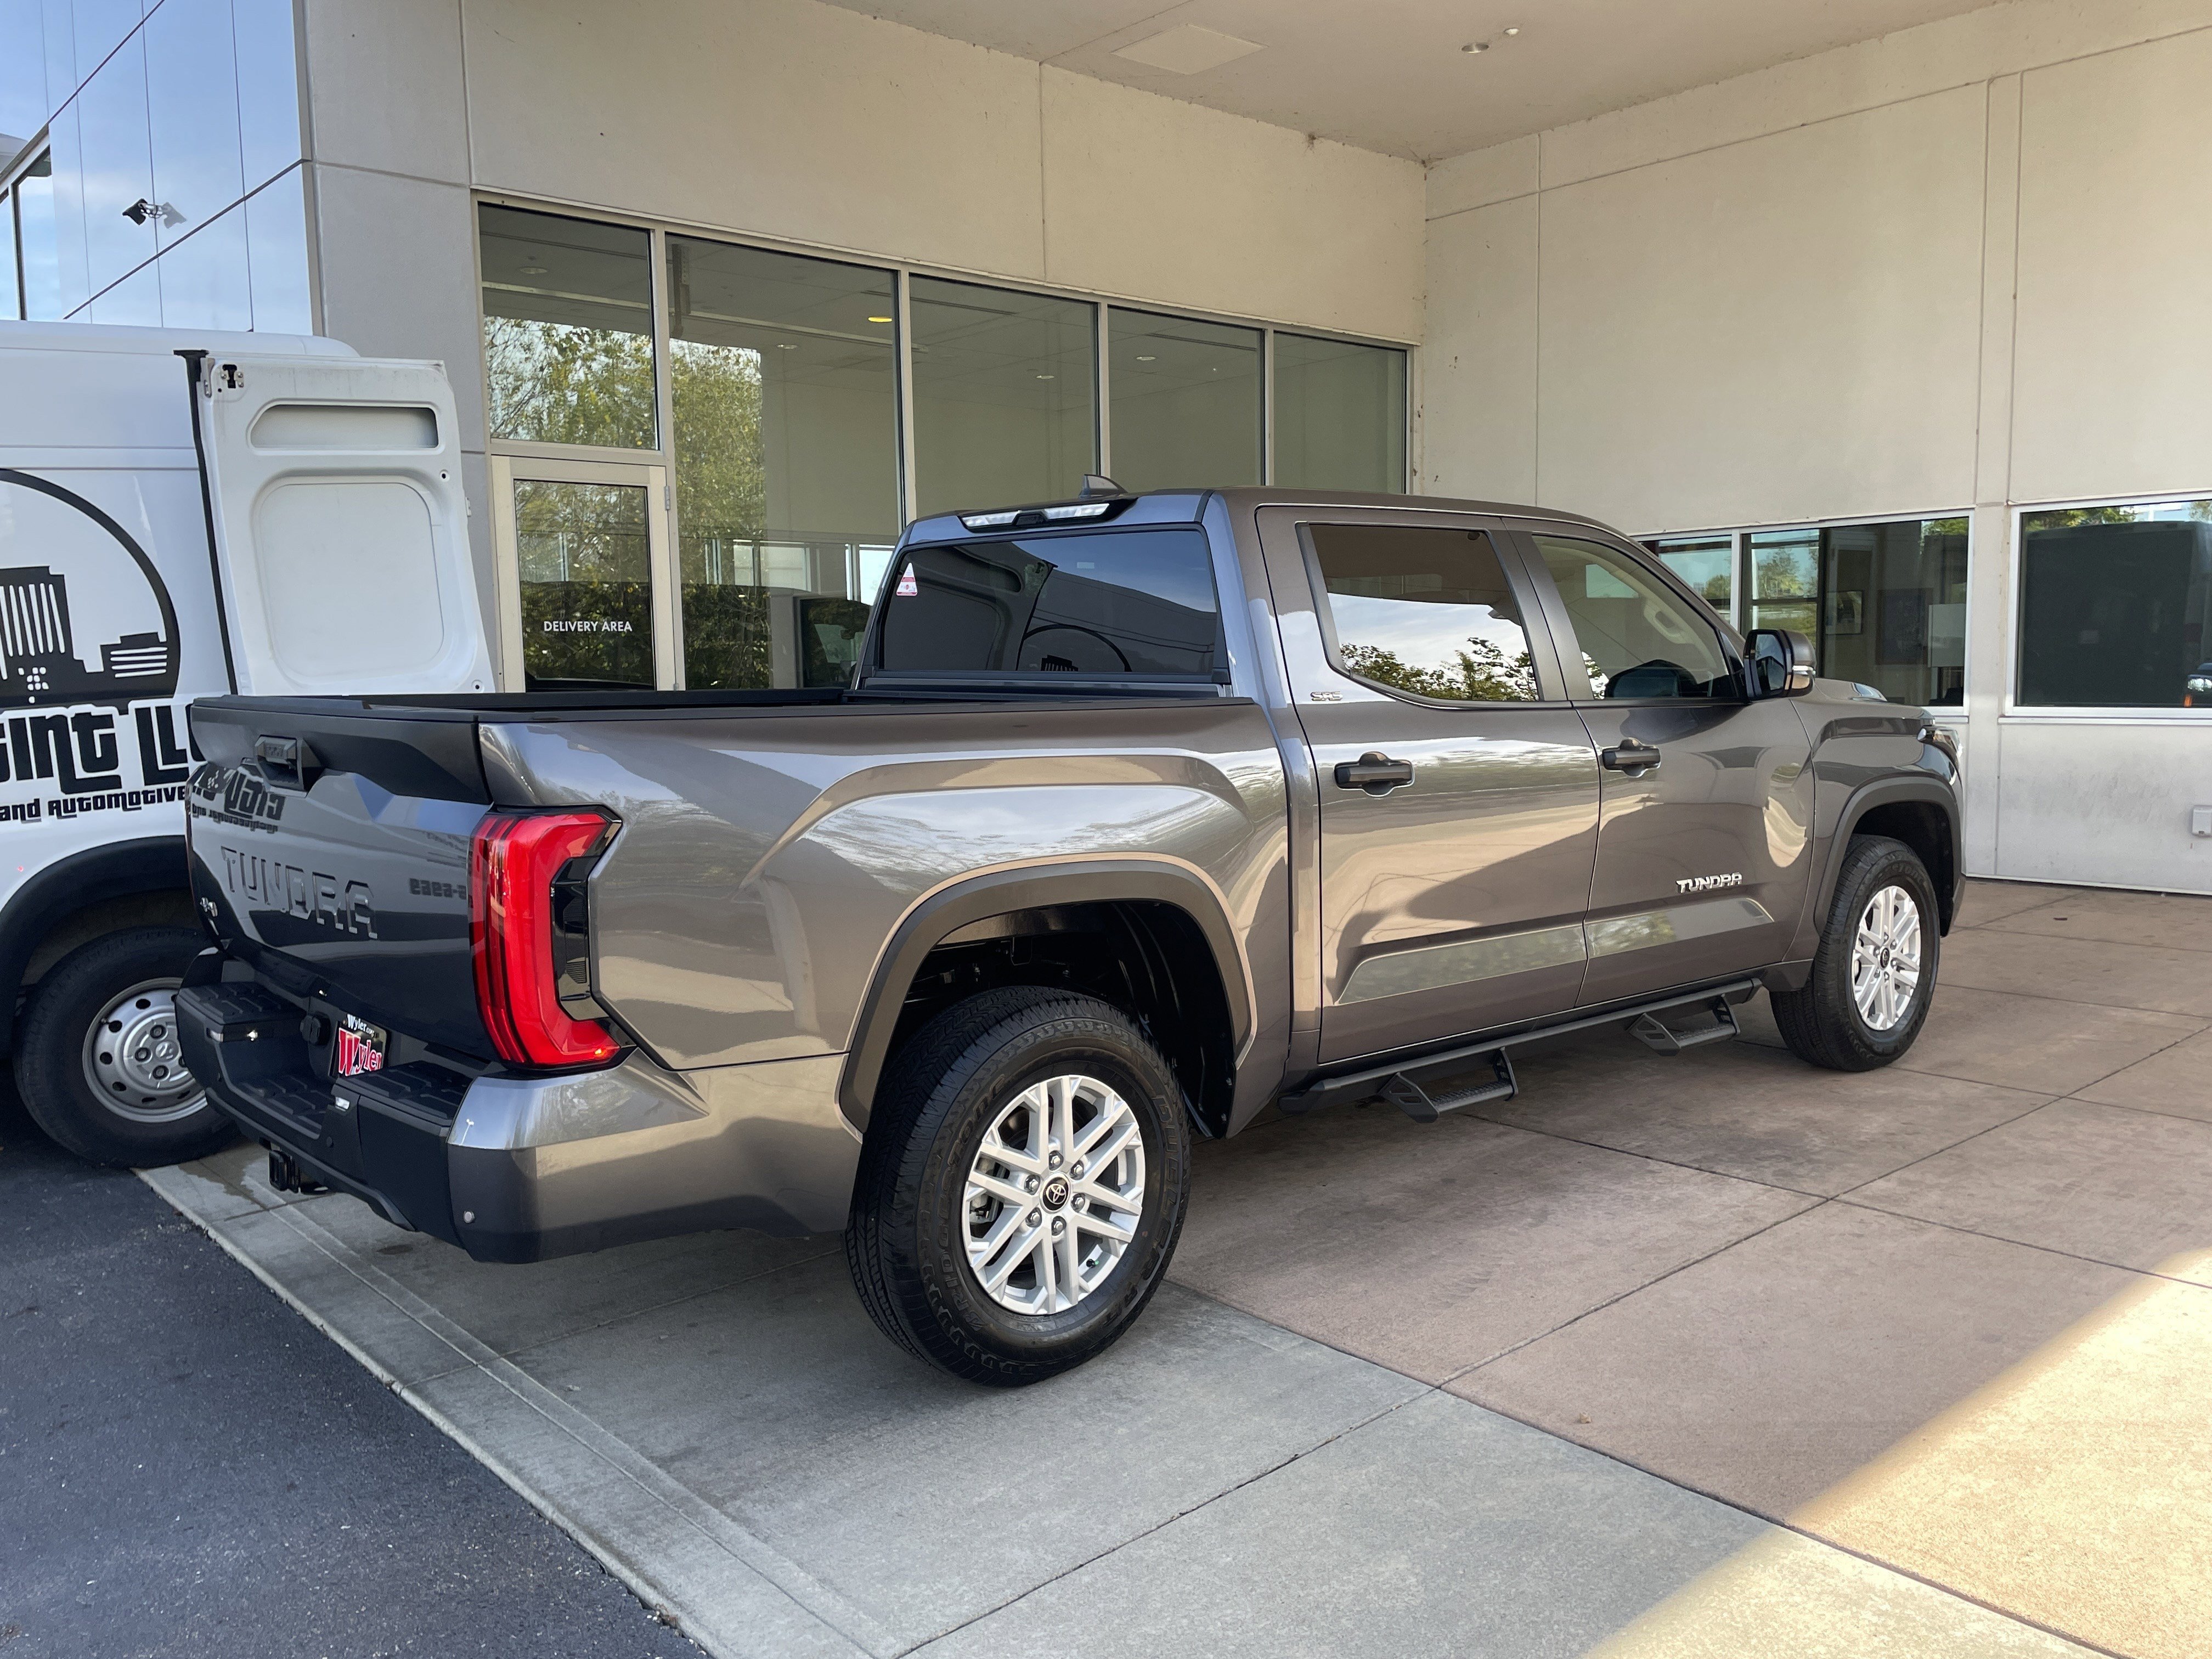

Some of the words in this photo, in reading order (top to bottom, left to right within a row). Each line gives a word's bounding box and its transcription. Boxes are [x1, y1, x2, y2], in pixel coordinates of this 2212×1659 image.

[544, 620, 598, 632] DELIVERY
[601, 620, 633, 633] AREA
[0, 712, 122, 795] int
[0, 798, 42, 823] and
[48, 786, 186, 819] Automotive
[221, 845, 377, 940] TUNDRA
[1675, 872, 1742, 894] TUNDRA
[338, 1026, 382, 1076] Wyler
